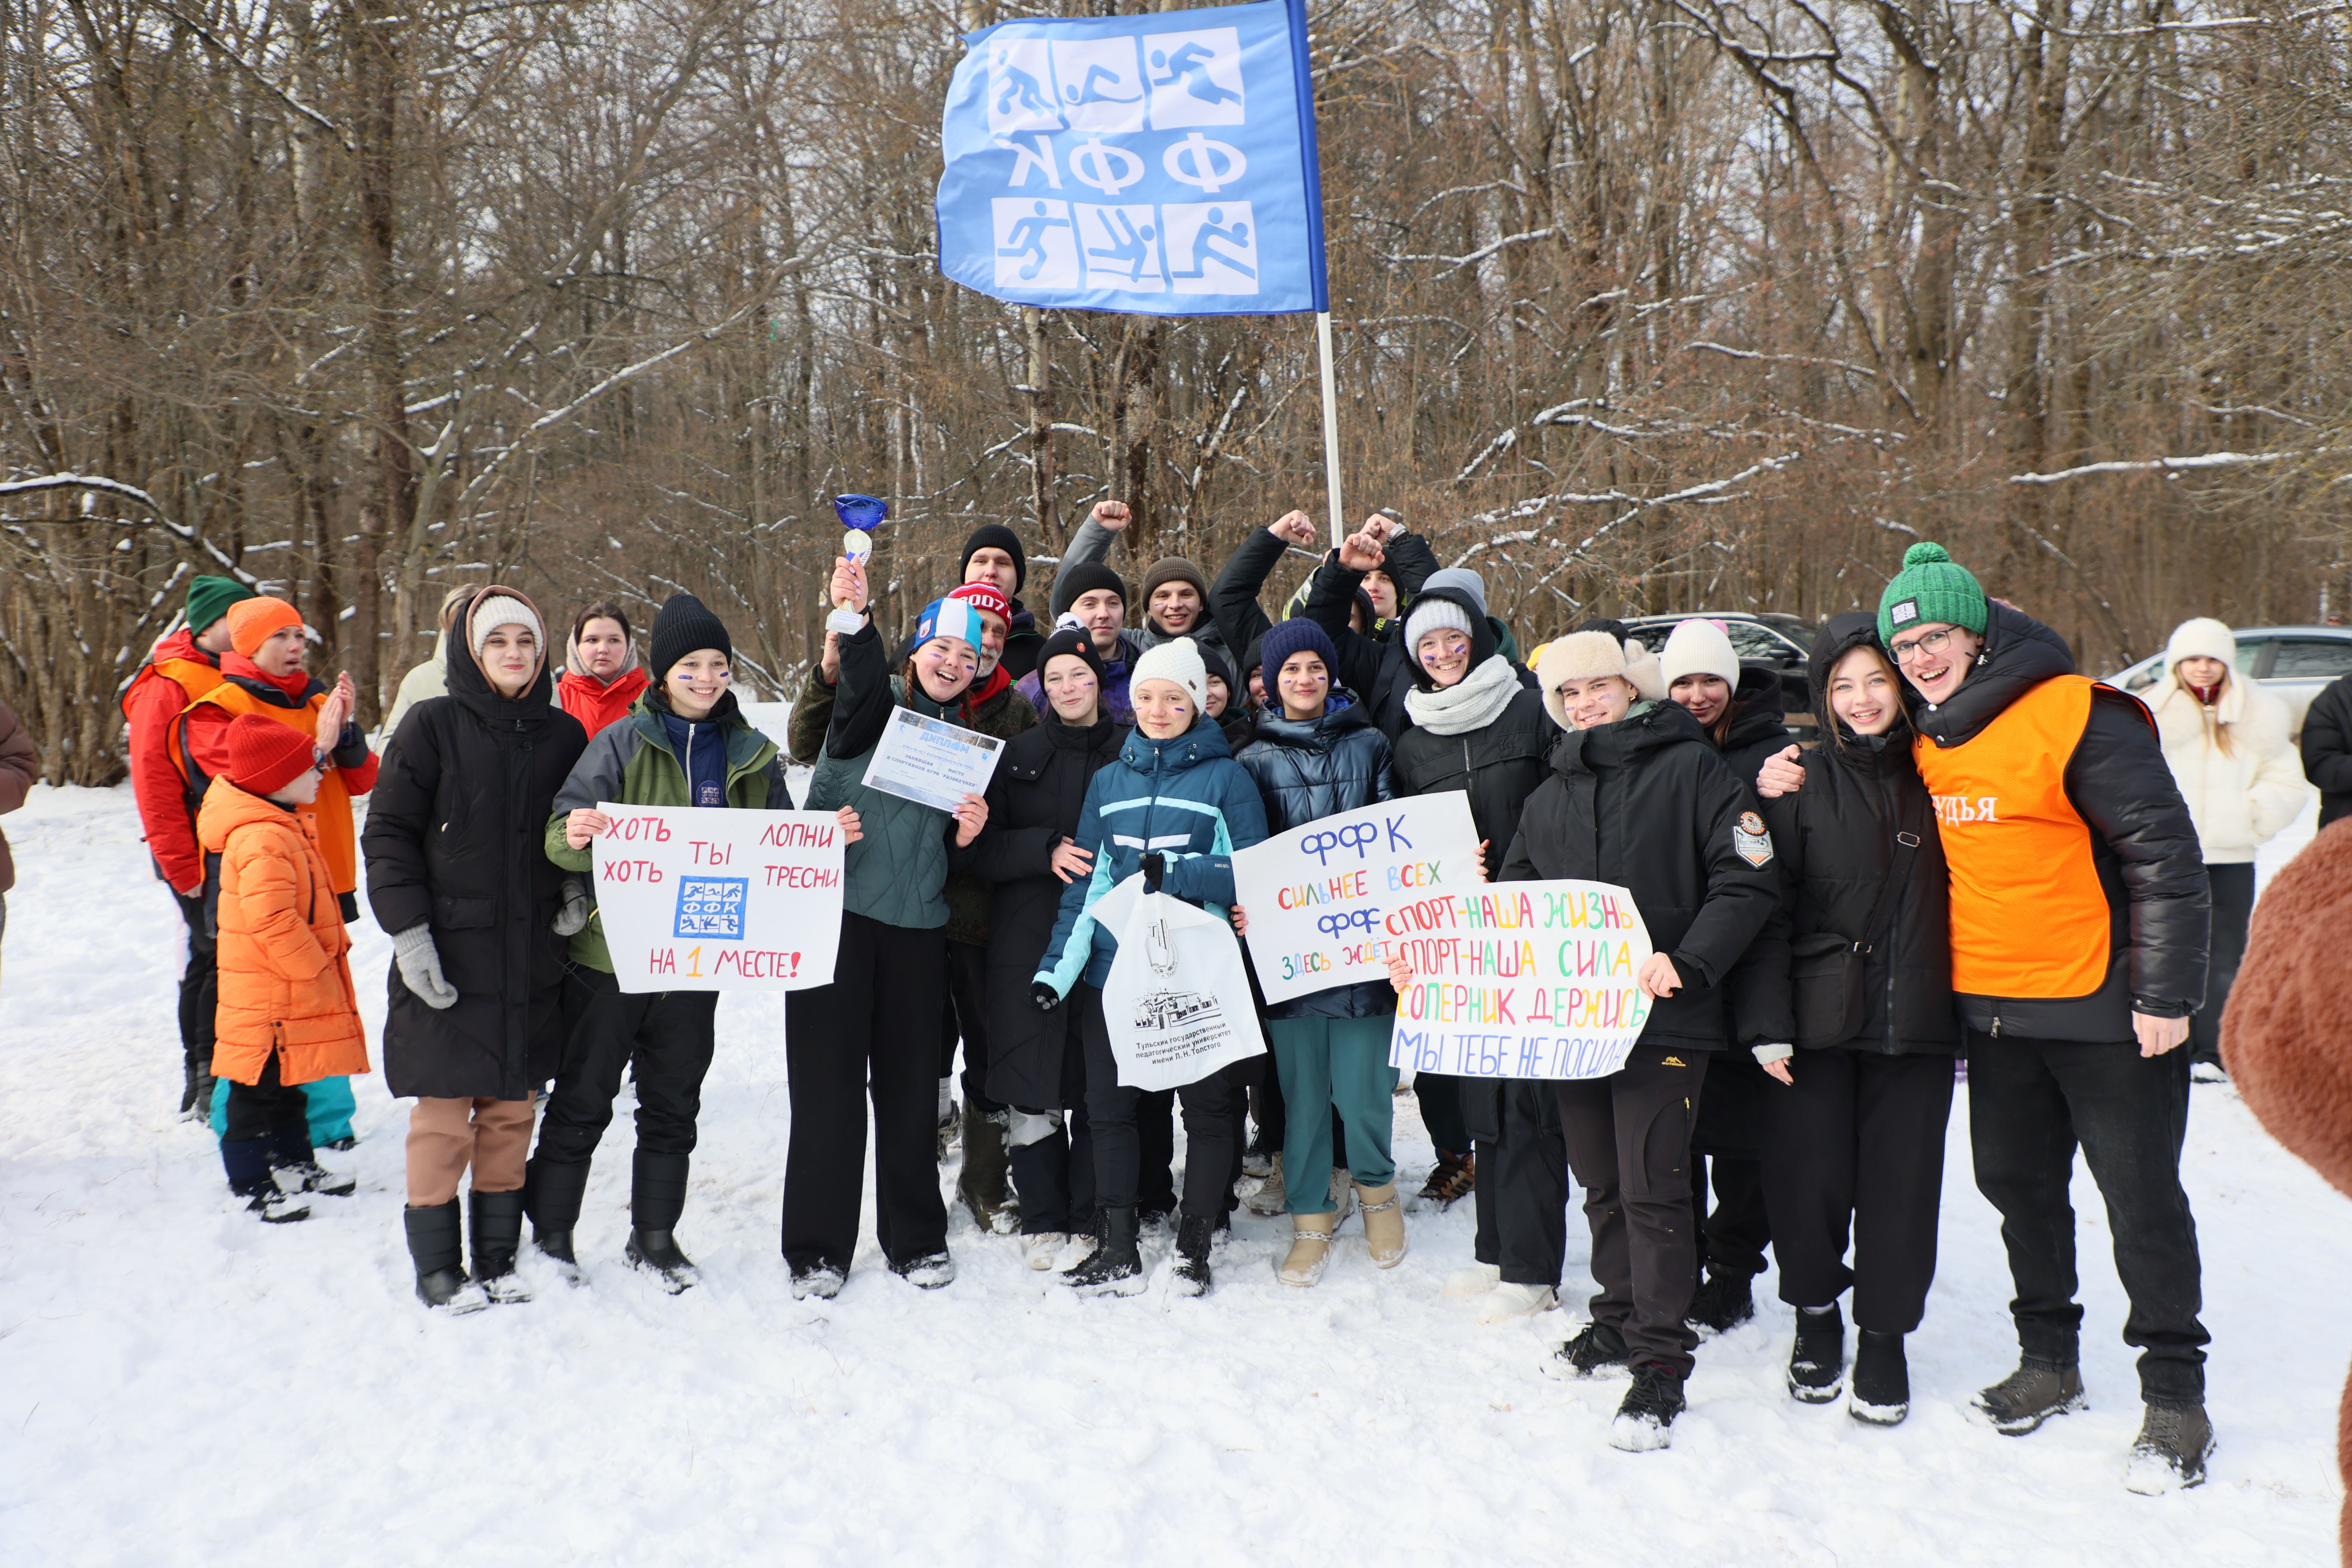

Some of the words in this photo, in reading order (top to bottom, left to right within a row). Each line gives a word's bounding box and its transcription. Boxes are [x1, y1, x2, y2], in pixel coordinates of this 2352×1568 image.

[919, 731, 970, 753] ДИПЛМ
[1931, 795, 1999, 827] УДЬЯ
[605, 817, 671, 842] ХОТЬ
[689, 841, 732, 865] ТЫ
[759, 823, 834, 848] ЛОПНИ
[1301, 814, 1413, 866] ФФК
[603, 860, 663, 883] ХОТЬ
[764, 865, 839, 888] ТРЕСНИ
[1278, 870, 1368, 910] СИЛЬНЕЕ
[1387, 860, 1442, 891] ВСЕХ
[683, 901, 738, 914] ФФК
[1385, 892, 1534, 936] СПОРТ-НАША
[1544, 891, 1633, 929] ЖИЗНЬ
[649, 947, 676, 974] НА
[686, 946, 703, 977] 1
[714, 949, 801, 978] МЕСТЕ!
[1281, 951, 1331, 980] ЗДЕСЬ
[1558, 940, 1632, 977] СИЛА
[1396, 983, 1516, 1025] СОПЕРНИК
[1526, 987, 1647, 1029] ДЕРЖИСЬ
[1136, 1038, 1168, 1050] Тульский
[1170, 1021, 1226, 1043] государственный
[1136, 1041, 1191, 1058] педагогический
[1192, 1030, 1231, 1047] университет
[1152, 1056, 1173, 1064] имени
[1191, 1042, 1221, 1055] Толстого
[1393, 1028, 1444, 1072] МЫ
[1453, 1035, 1512, 1077] ТЕБЕ
[1517, 1036, 1549, 1077] НЕ
